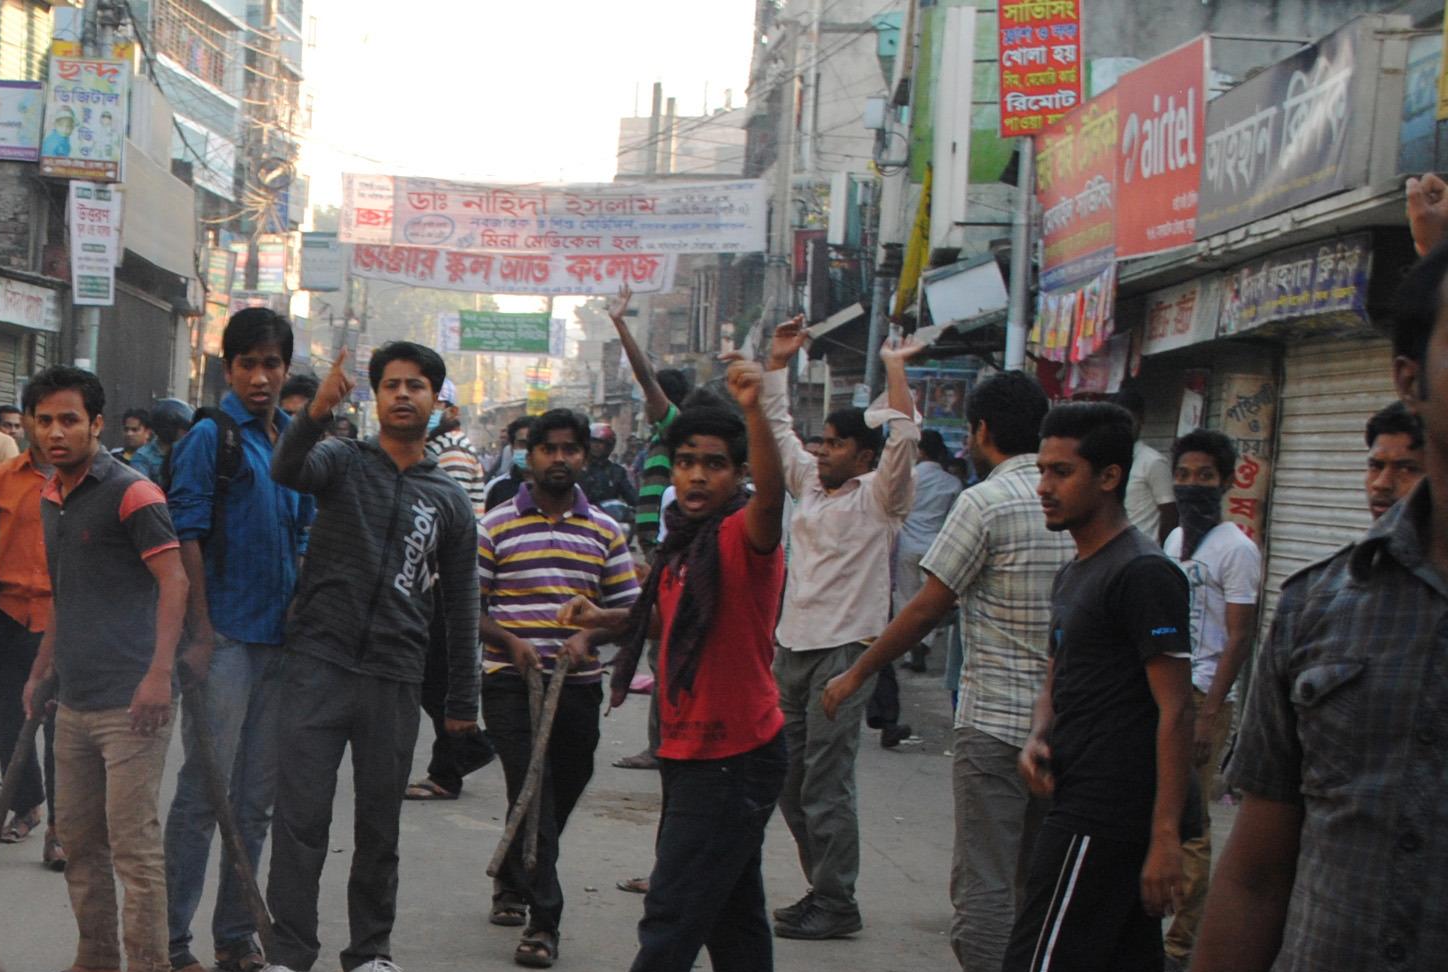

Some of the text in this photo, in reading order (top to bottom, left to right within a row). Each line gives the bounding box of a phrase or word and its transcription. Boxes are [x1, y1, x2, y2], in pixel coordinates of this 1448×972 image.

[1002, 44, 1078, 66] খোলা হয়
[56, 60, 123, 84] ছন্দ
[54, 85, 121, 106] ডিজিটাল
[1003, 89, 1078, 112] রিমোট
[1141, 86, 1197, 180] airtel
[407, 190, 449, 212] ডাঃ
[457, 188, 549, 217] নাহিদা
[565, 192, 660, 217] ইসলাম
[481, 229, 519, 249] মিনা
[524, 229, 602, 249] মেডিকেল
[444, 250, 496, 285] স্কুল
[565, 253, 665, 284] কলেজ
[394, 498, 437, 597] Reebok
